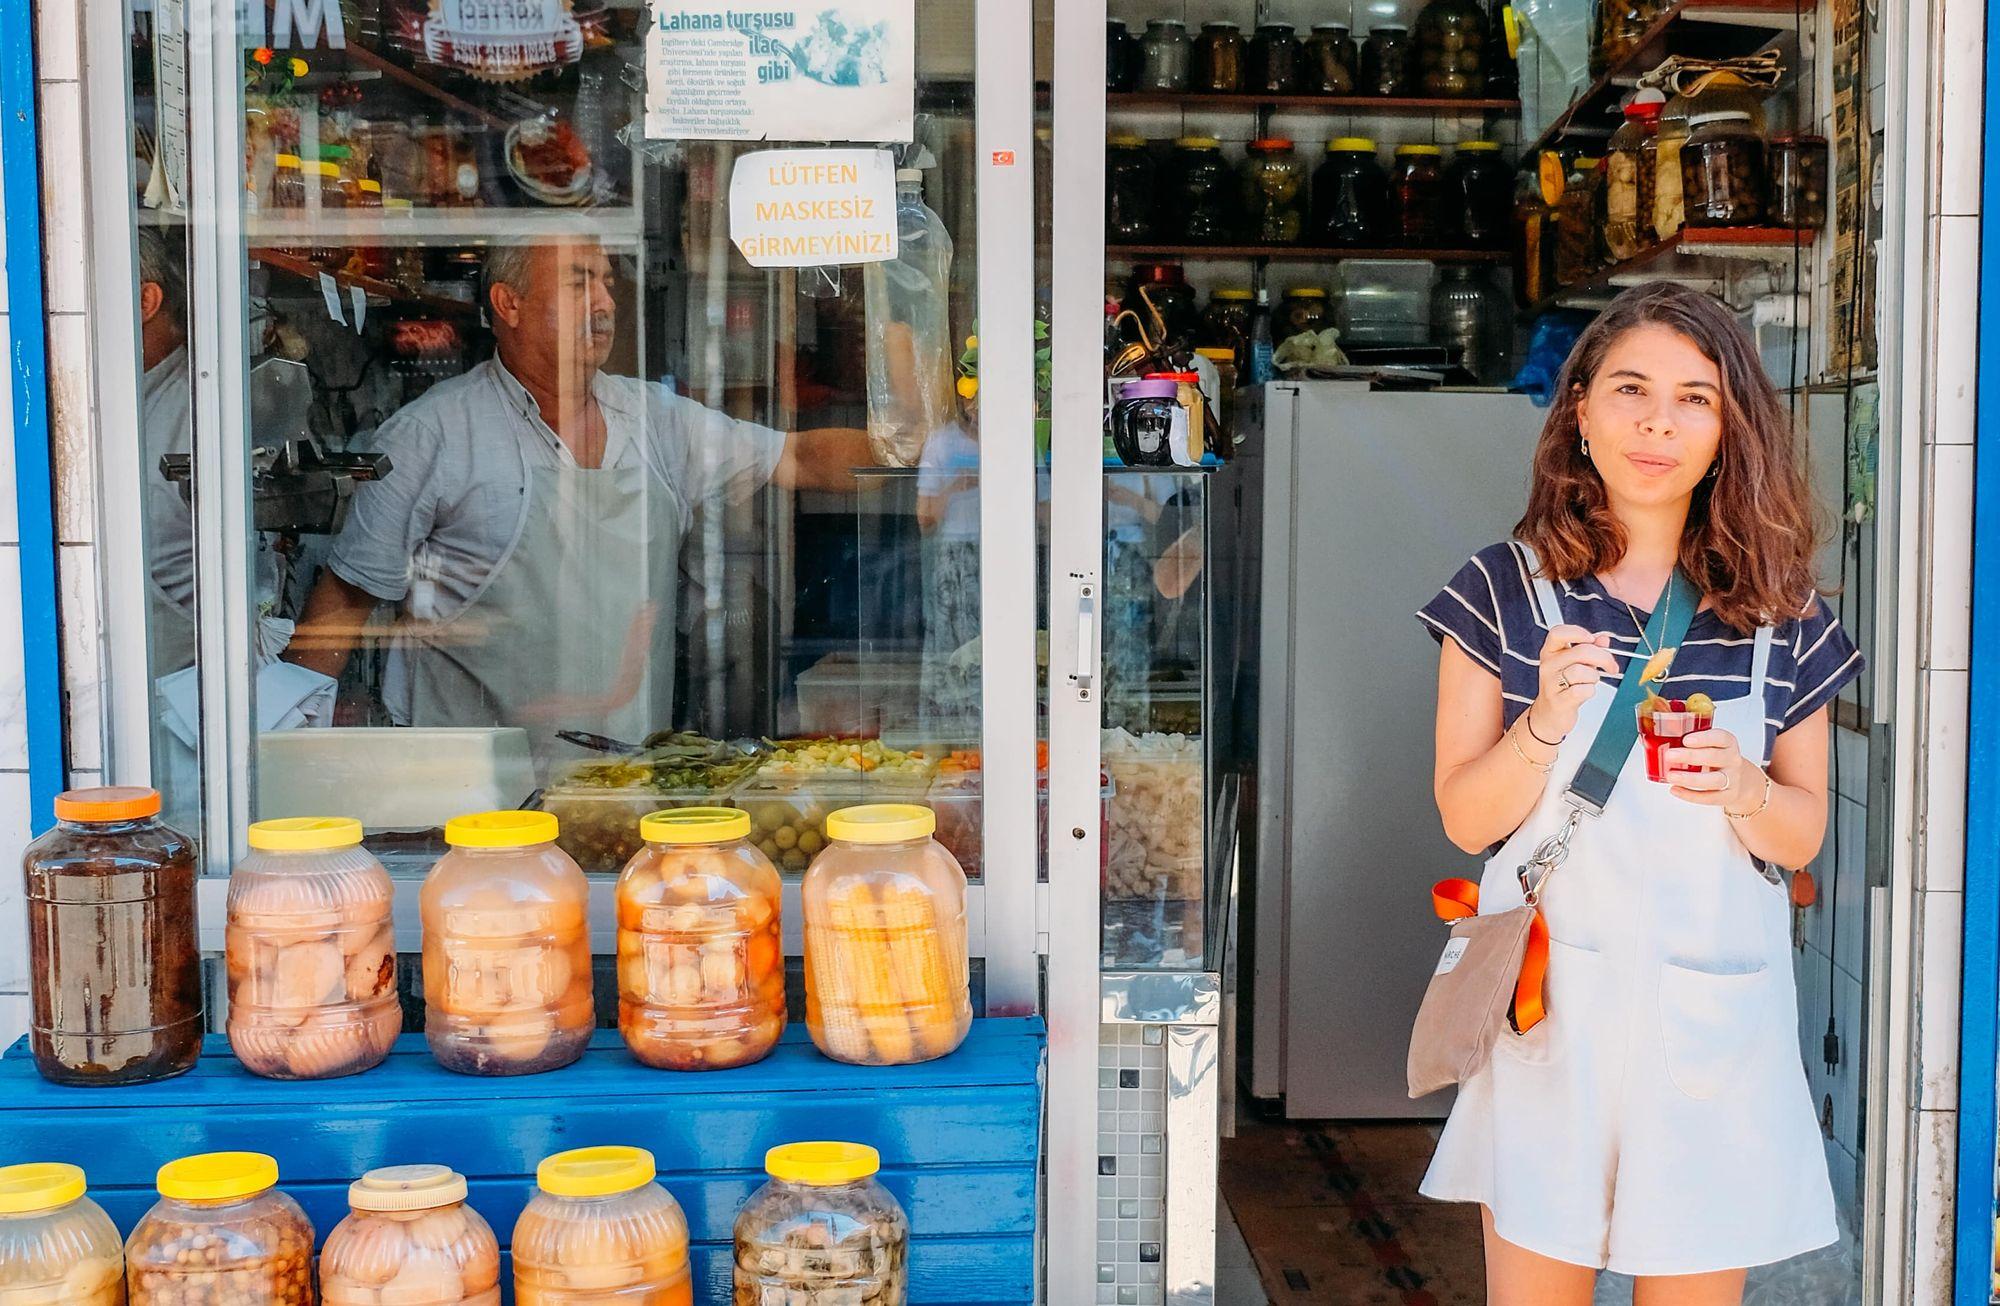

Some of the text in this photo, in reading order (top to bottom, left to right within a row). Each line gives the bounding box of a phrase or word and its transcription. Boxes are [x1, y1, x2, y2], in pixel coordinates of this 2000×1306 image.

[660, 9, 793, 30] Lahana turşusu
[749, 35, 779, 56] ilaç
[668, 68, 681, 78] gibi
[696, 58, 718, 66] lahana
[757, 60, 789, 84] gibi
[769, 162, 858, 186] LÜTFEN
[755, 195, 875, 222] MASKESİZ
[741, 230, 891, 258] GİRMEYİNİZ!
